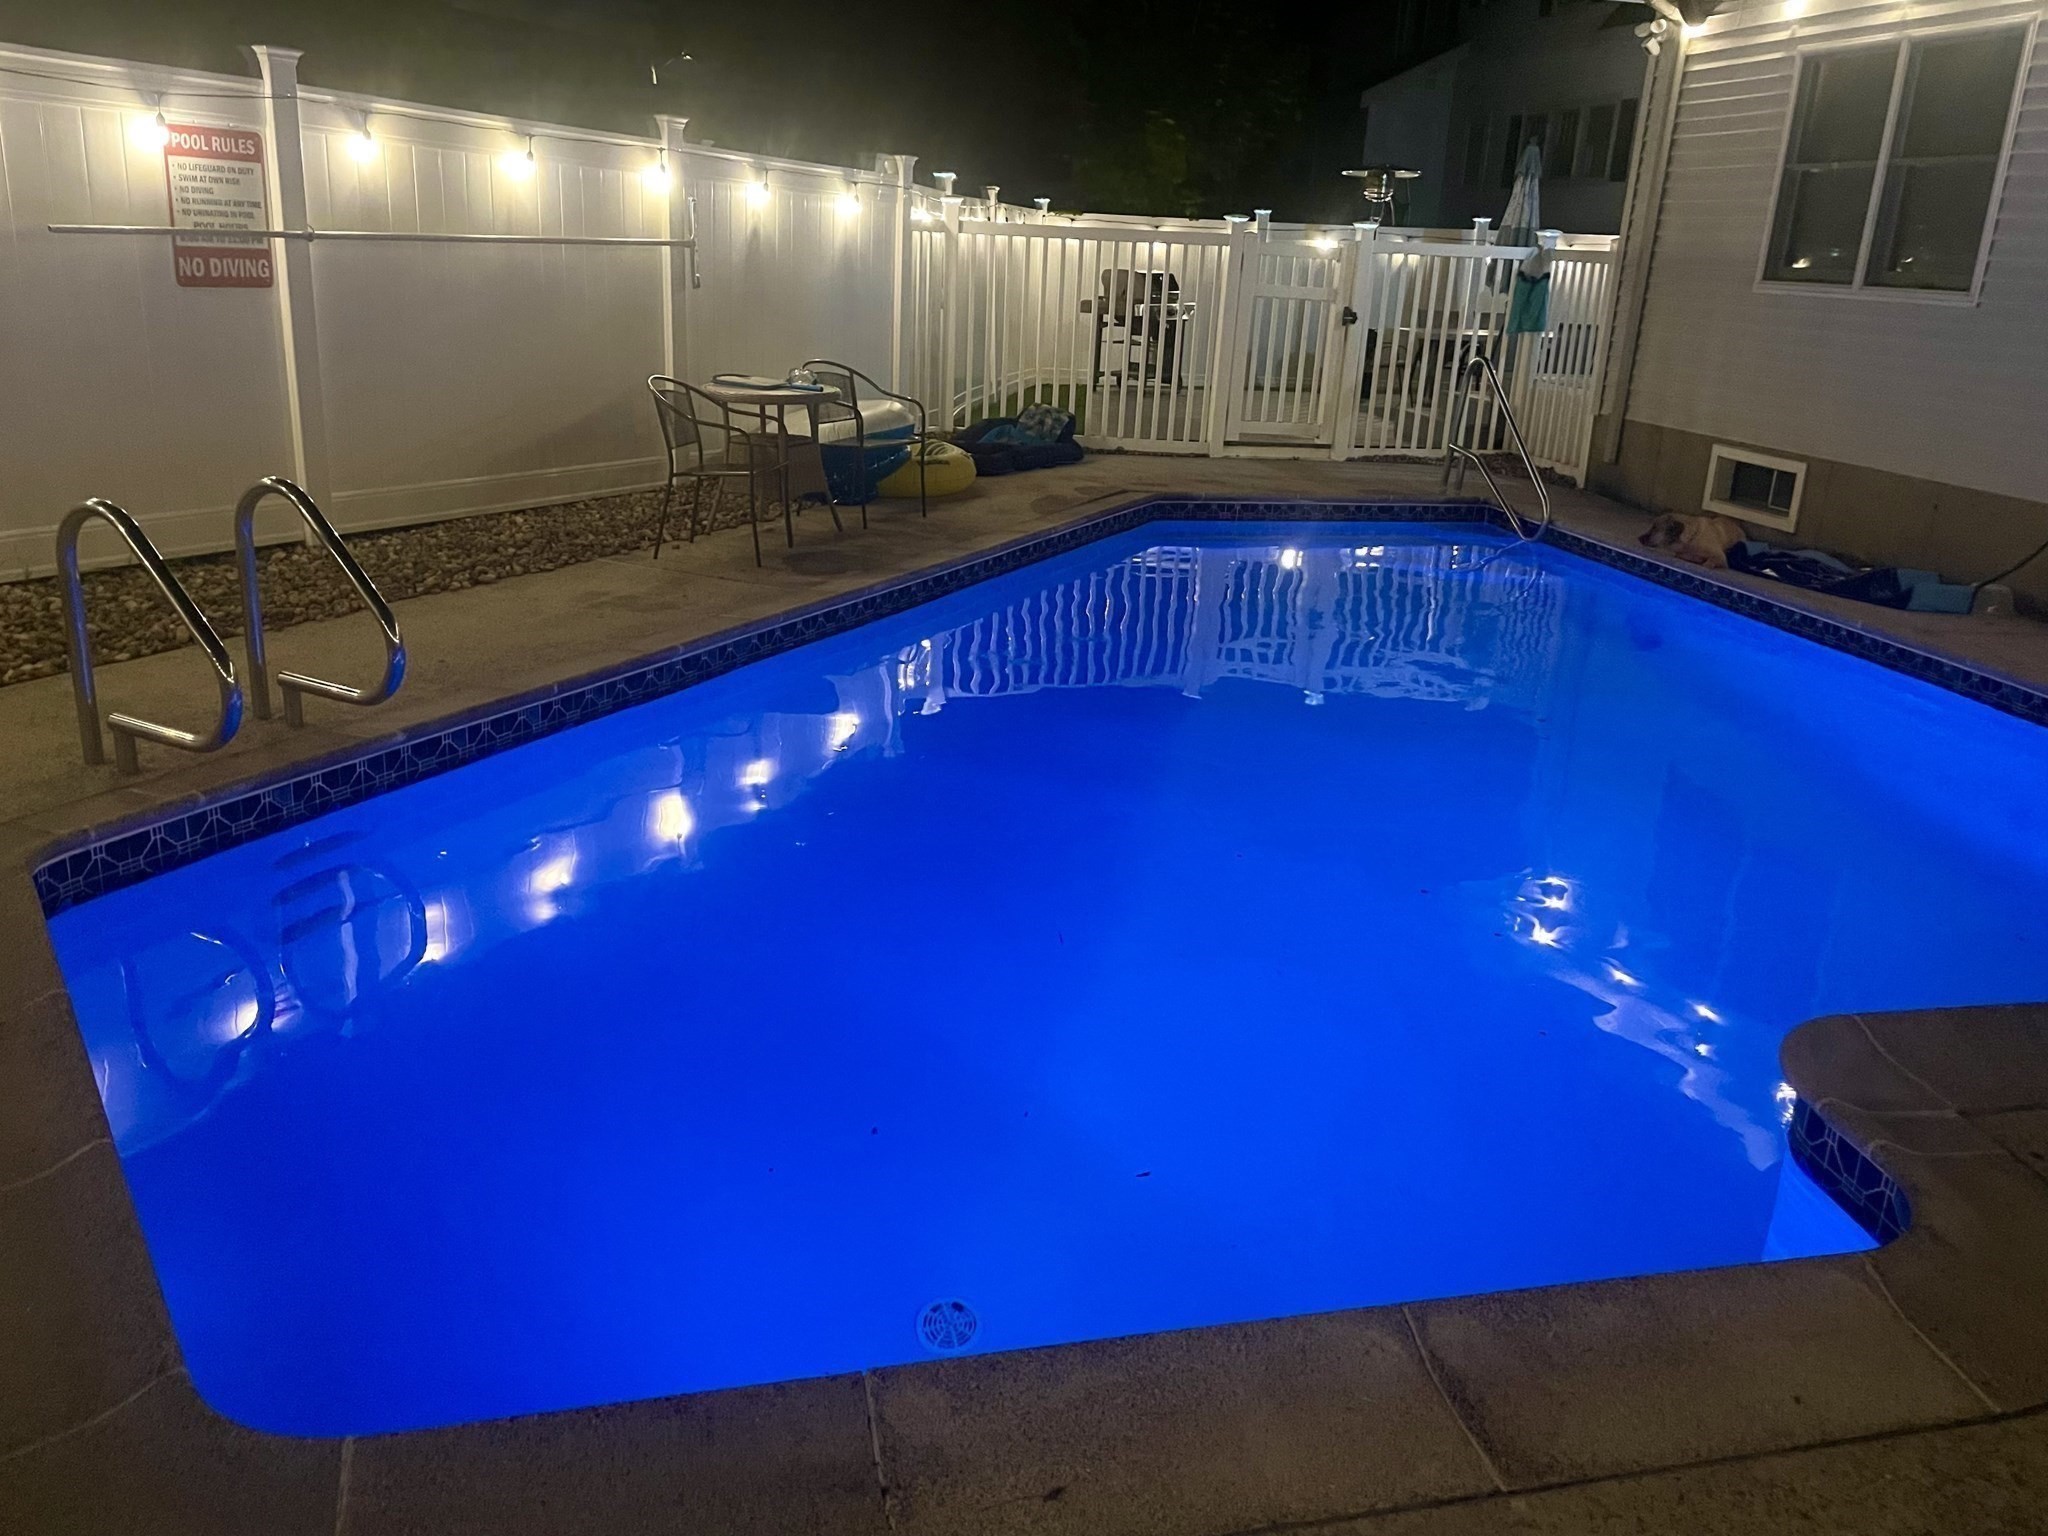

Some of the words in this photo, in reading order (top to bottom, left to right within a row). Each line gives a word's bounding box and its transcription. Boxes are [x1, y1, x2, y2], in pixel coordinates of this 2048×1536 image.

[171, 132, 208, 151] POOL
[212, 137, 255, 155] RULES
[177, 163, 187, 171] NO
[189, 163, 226, 174] LIFEGUARD
[227, 166, 236, 174] ON
[238, 167, 254, 176] DUTY
[199, 175, 207, 183] AT
[208, 176, 224, 184] OWN
[225, 177, 241, 185] RISK
[179, 186, 189, 194] NO
[191, 186, 214, 195] DIVING
[180, 197, 190, 205] NO
[192, 198, 223, 207] RUNNING
[224, 199, 232, 207] AT
[182, 209, 191, 217] NO
[193, 210, 229, 218] URINATING
[230, 211, 238, 219] IN
[239, 211, 255, 219] POOL
[178, 257, 204, 277] NO
[210, 258, 270, 278] DIVING
